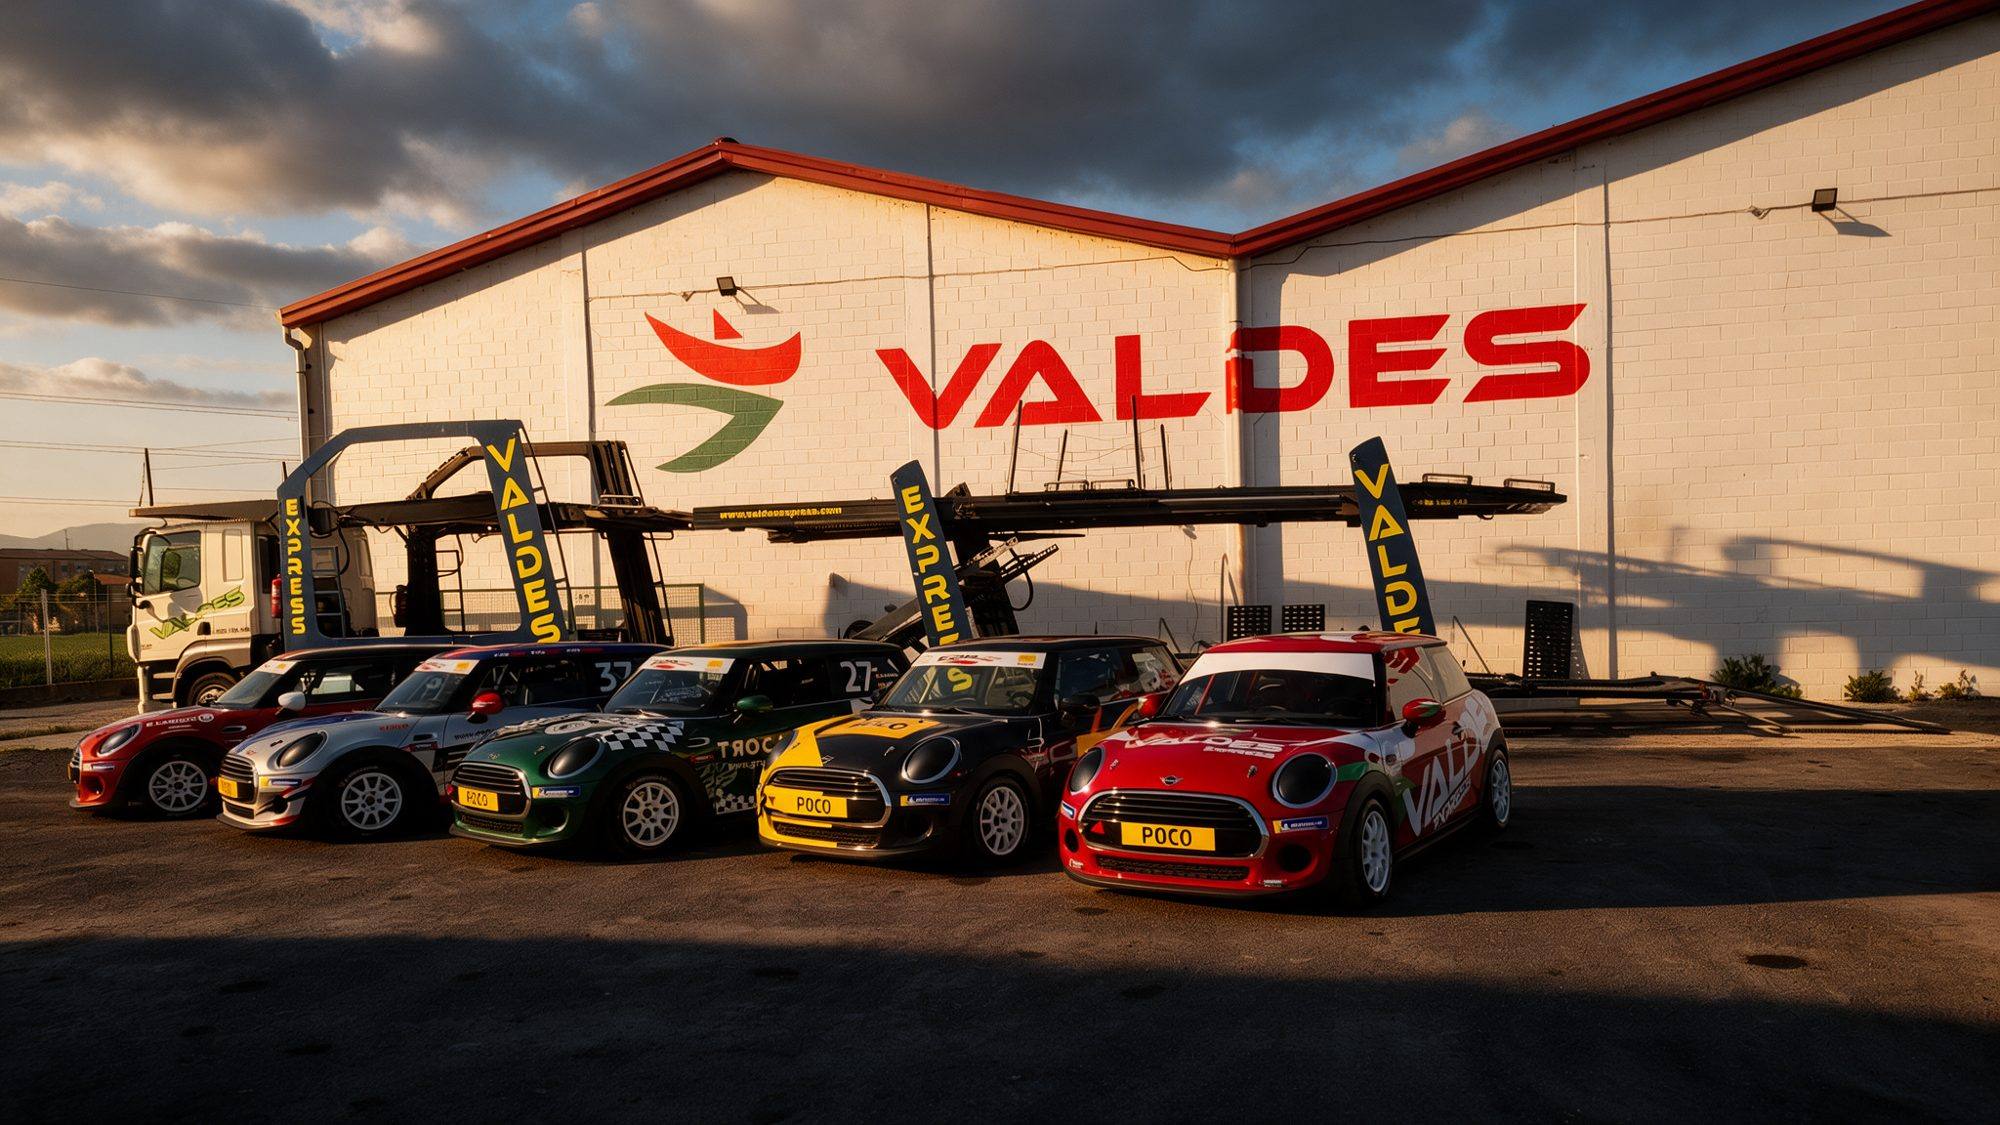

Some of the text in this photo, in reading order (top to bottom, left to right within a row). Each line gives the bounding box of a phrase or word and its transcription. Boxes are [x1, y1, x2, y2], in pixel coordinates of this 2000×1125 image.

[875, 303, 1591, 430] VALDES
[486, 438, 561, 643] VALDES
[285, 498, 306, 634] EXPRESS
[595, 661, 632, 692] 37
[840, 661, 871, 692] 27
[797, 797, 831, 814] POCO
[1142, 827, 1192, 847] POCO
